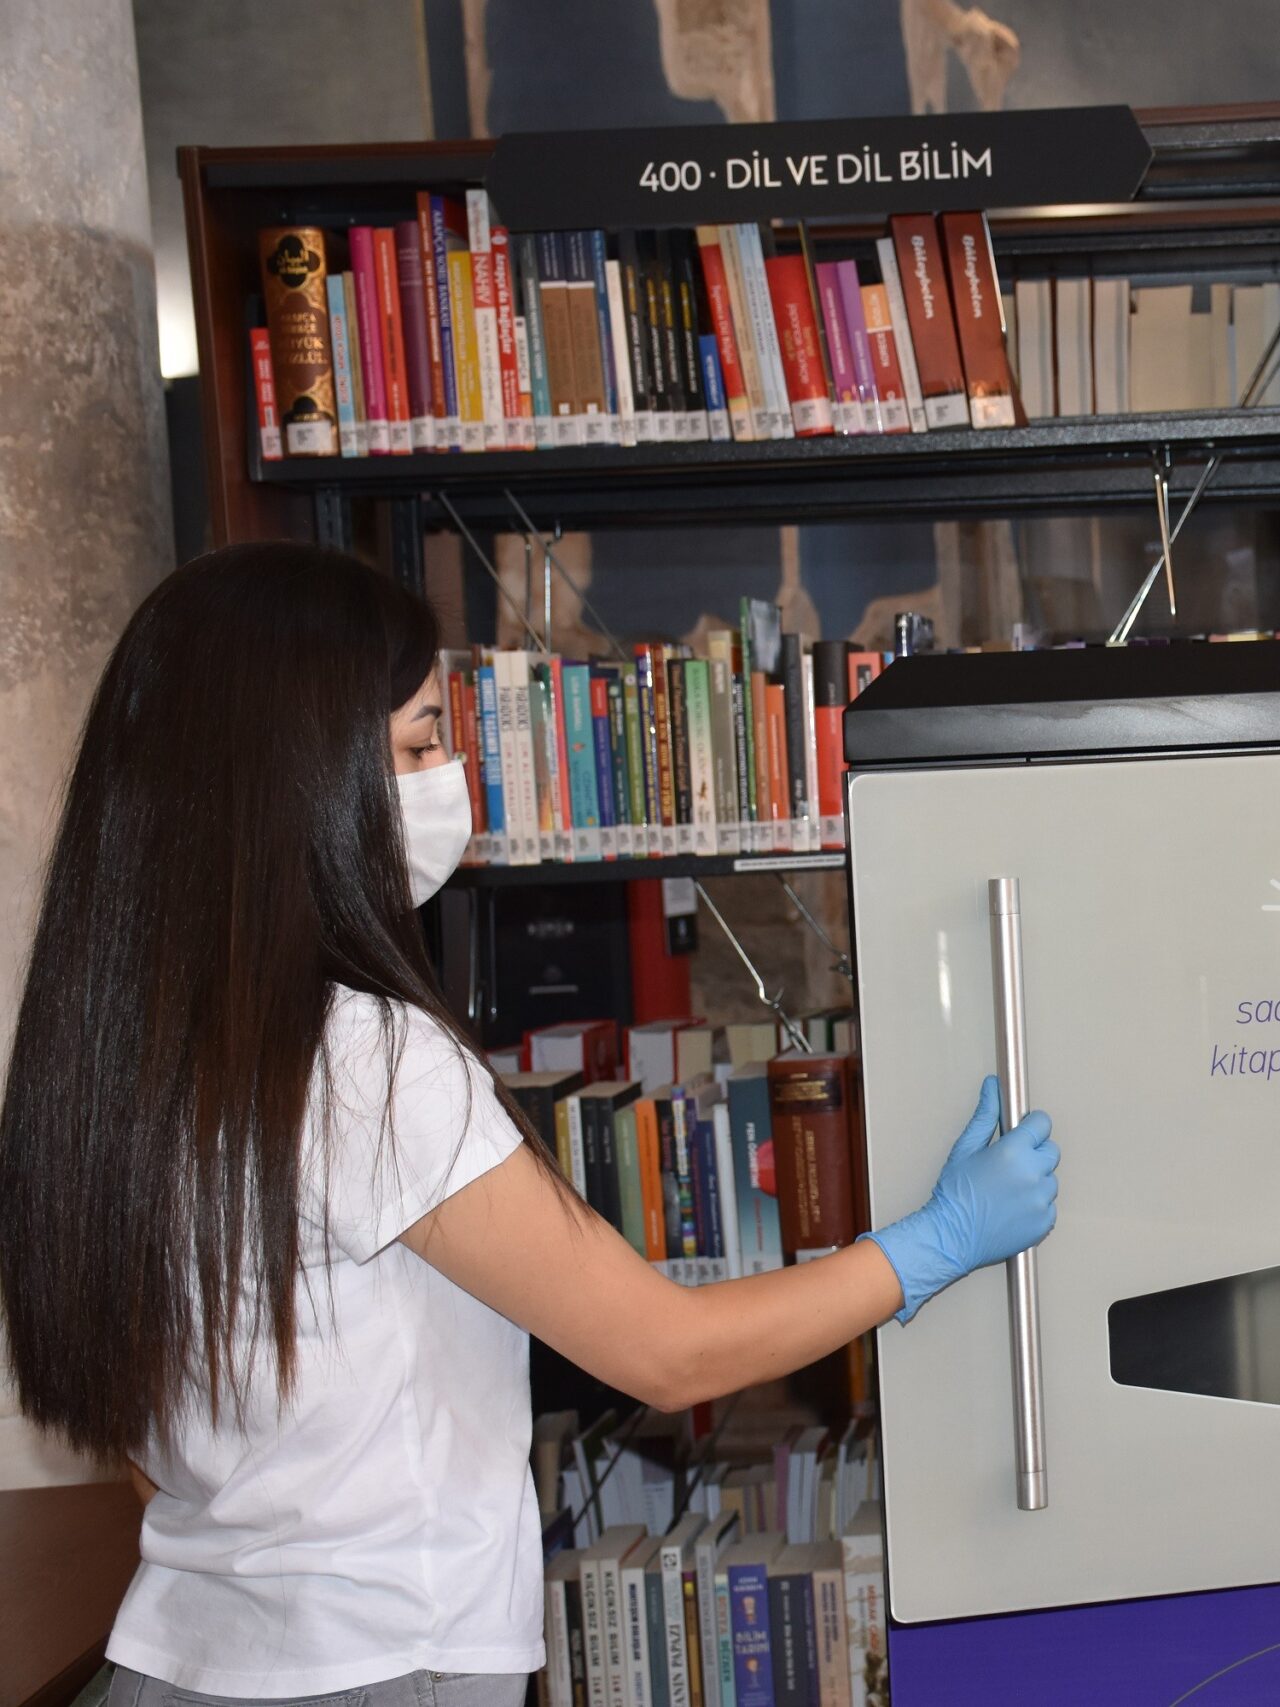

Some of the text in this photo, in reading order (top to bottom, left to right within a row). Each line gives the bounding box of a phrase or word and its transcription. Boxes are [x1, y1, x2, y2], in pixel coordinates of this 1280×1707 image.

[640, 140, 993, 193] 400 DİL VE DİL BİLİM
